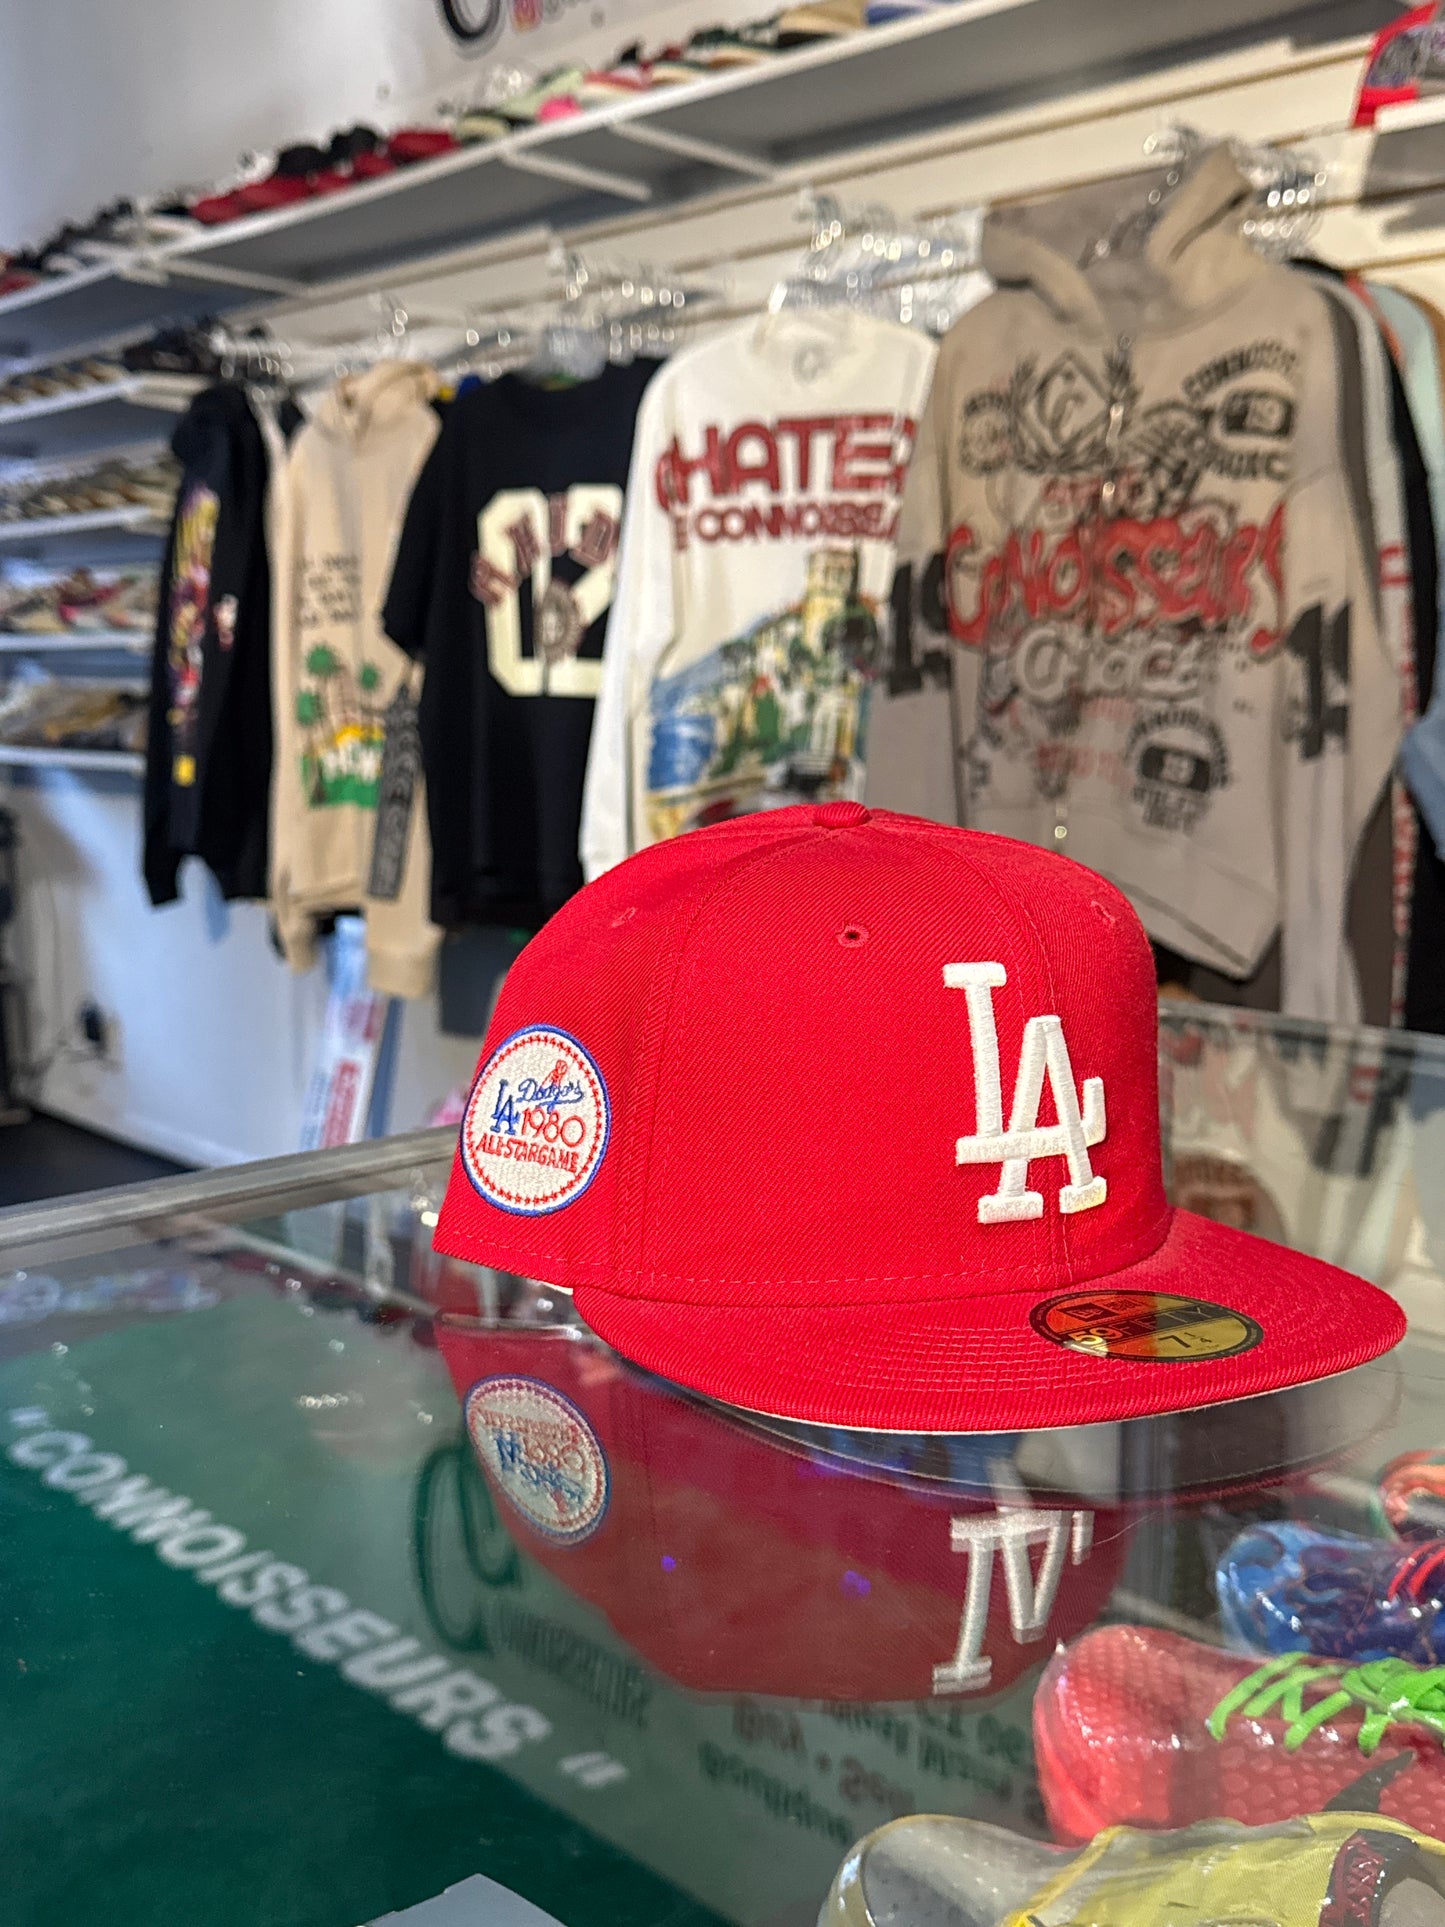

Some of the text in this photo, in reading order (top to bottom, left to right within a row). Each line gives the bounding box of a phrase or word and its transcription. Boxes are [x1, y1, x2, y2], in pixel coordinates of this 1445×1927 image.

[489, 1079, 521, 1135] LA
[517, 1078, 585, 1115] Dodgers
[943, 961, 1107, 1223] LA
[521, 1106, 587, 1148] 1980
